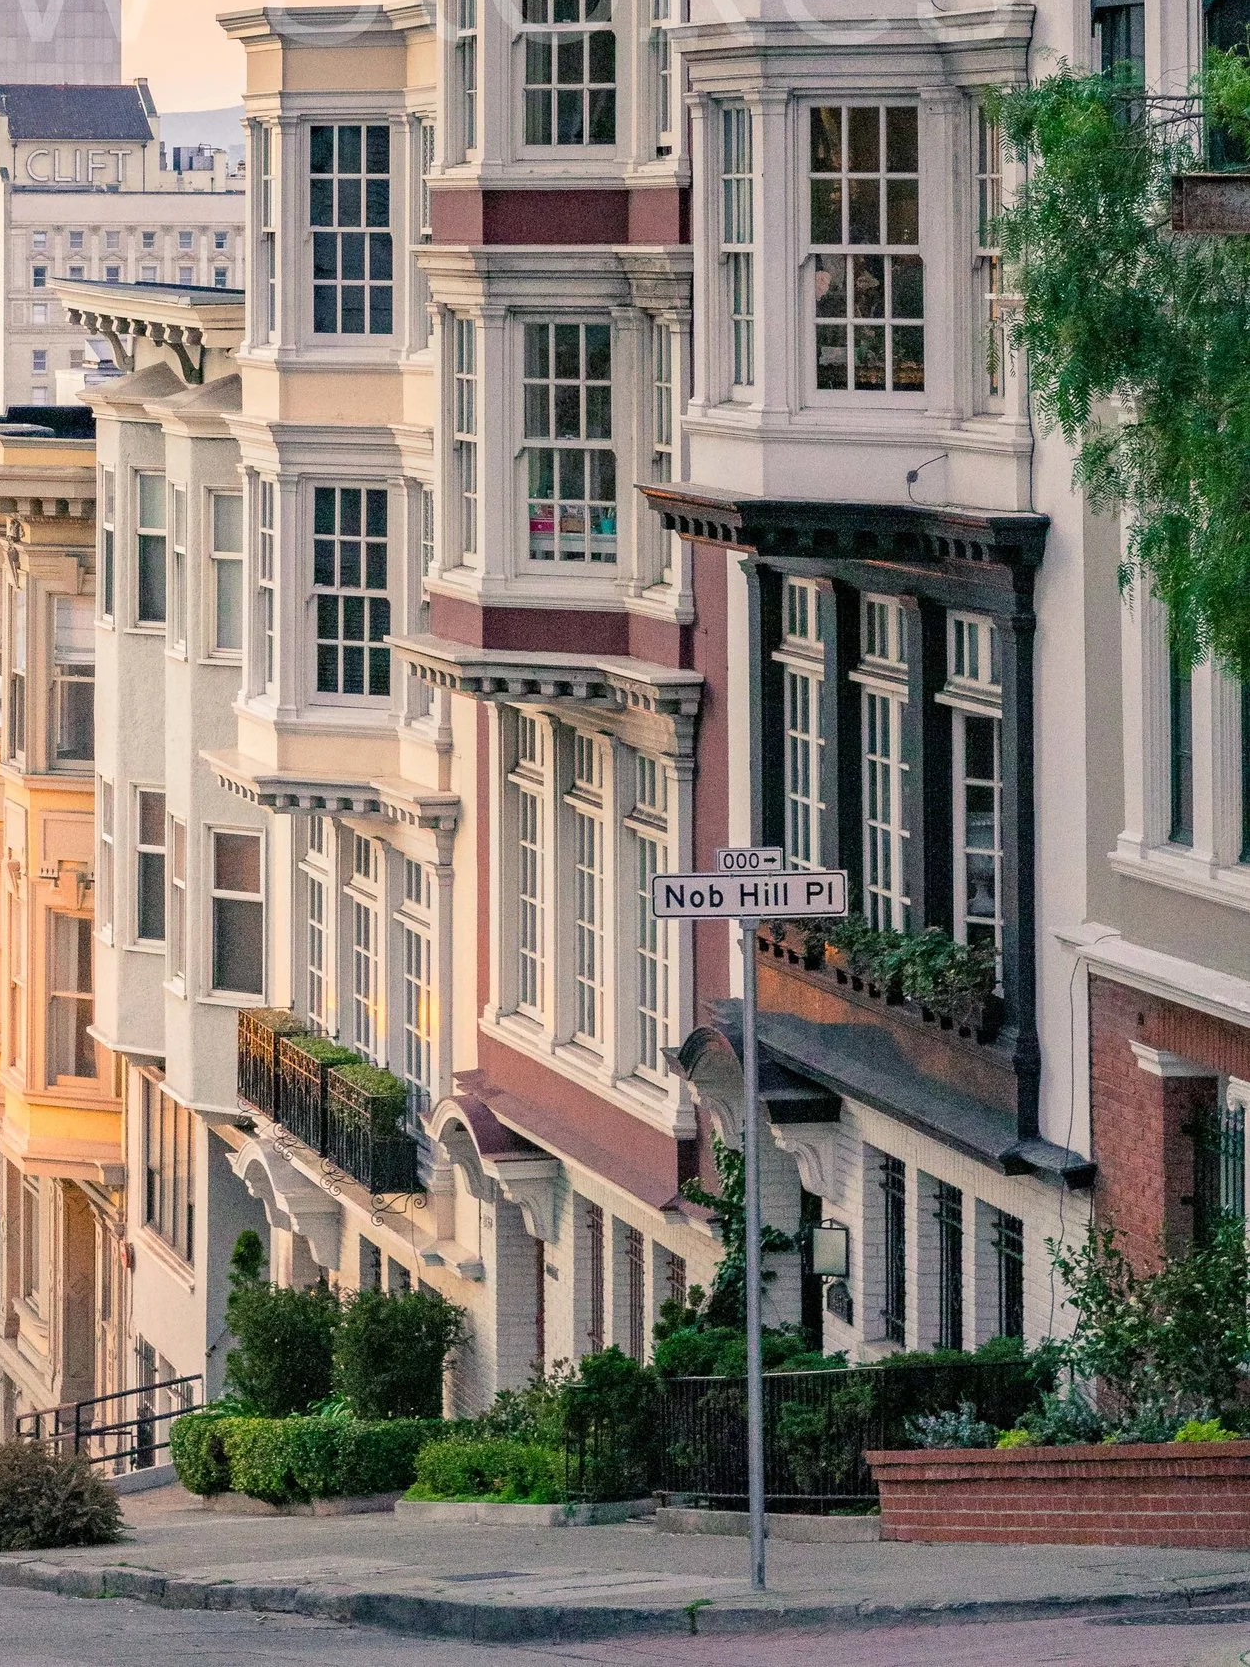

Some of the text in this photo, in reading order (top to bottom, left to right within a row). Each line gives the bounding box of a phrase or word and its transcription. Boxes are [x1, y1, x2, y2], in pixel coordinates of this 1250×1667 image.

[26, 148, 132, 183] CLIFT
[723, 852, 760, 869] 000
[665, 881, 833, 908] Nob Hill Pl
